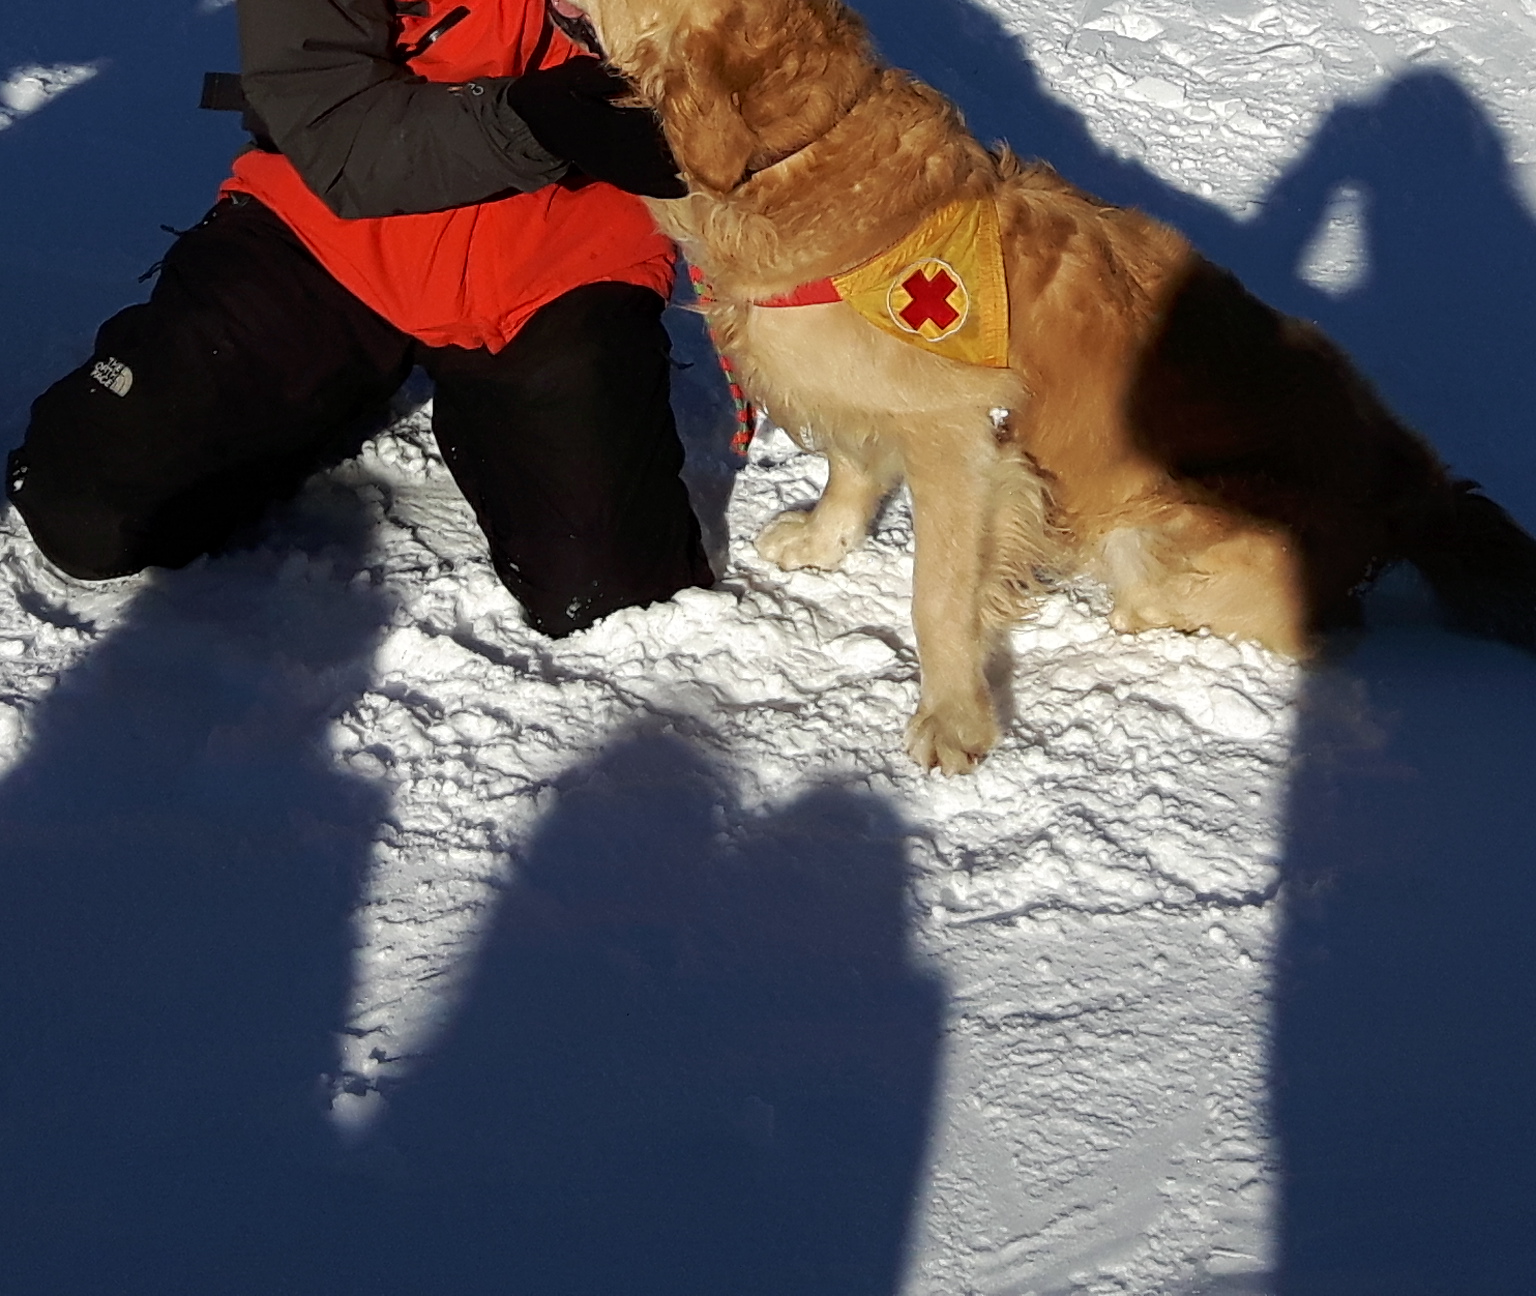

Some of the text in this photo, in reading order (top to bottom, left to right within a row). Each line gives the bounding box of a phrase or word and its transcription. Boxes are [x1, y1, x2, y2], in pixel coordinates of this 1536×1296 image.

[94, 361, 120, 381] ORTH
[108, 356, 125, 373] THE
[90, 369, 115, 388] FACE
